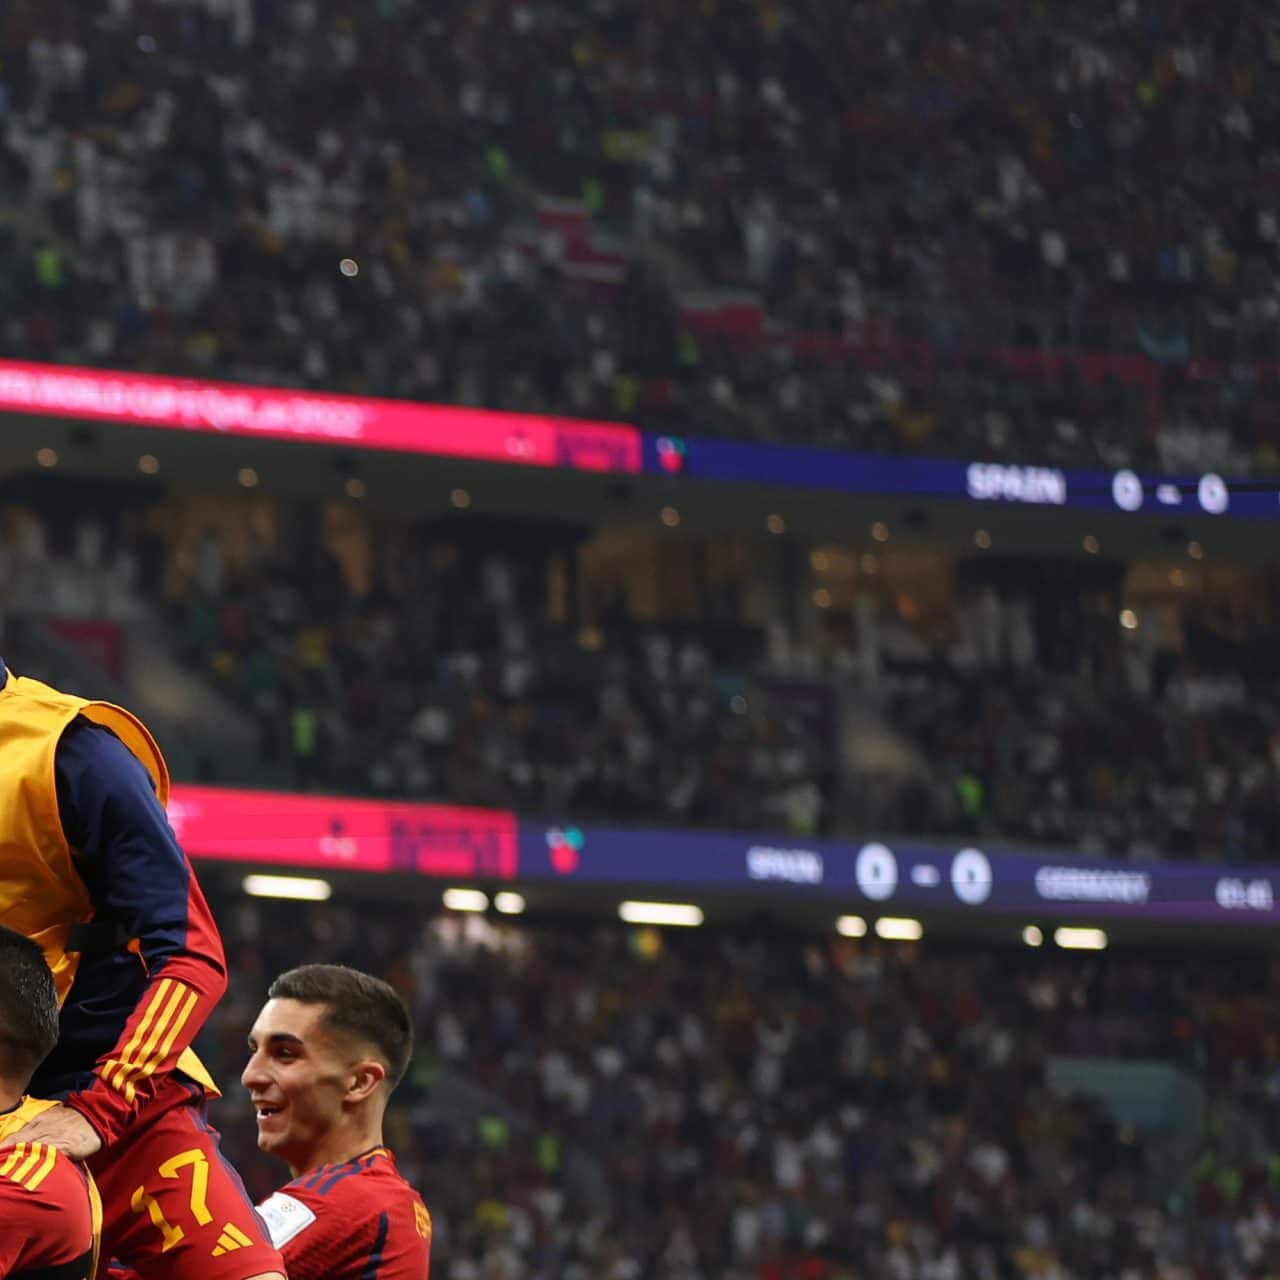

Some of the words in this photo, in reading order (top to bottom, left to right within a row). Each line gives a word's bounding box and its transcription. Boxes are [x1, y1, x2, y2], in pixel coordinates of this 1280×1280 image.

[967, 462, 1066, 505] SPAIN
[1113, 469, 1142, 512] 0
[1198, 472, 1230, 515] 0
[745, 844, 824, 885] SPAIN
[855, 841, 898, 902] 0
[950, 847, 992, 904] 0
[1035, 865, 1150, 904] GERMANY
[130, 1148, 214, 1253] 17
